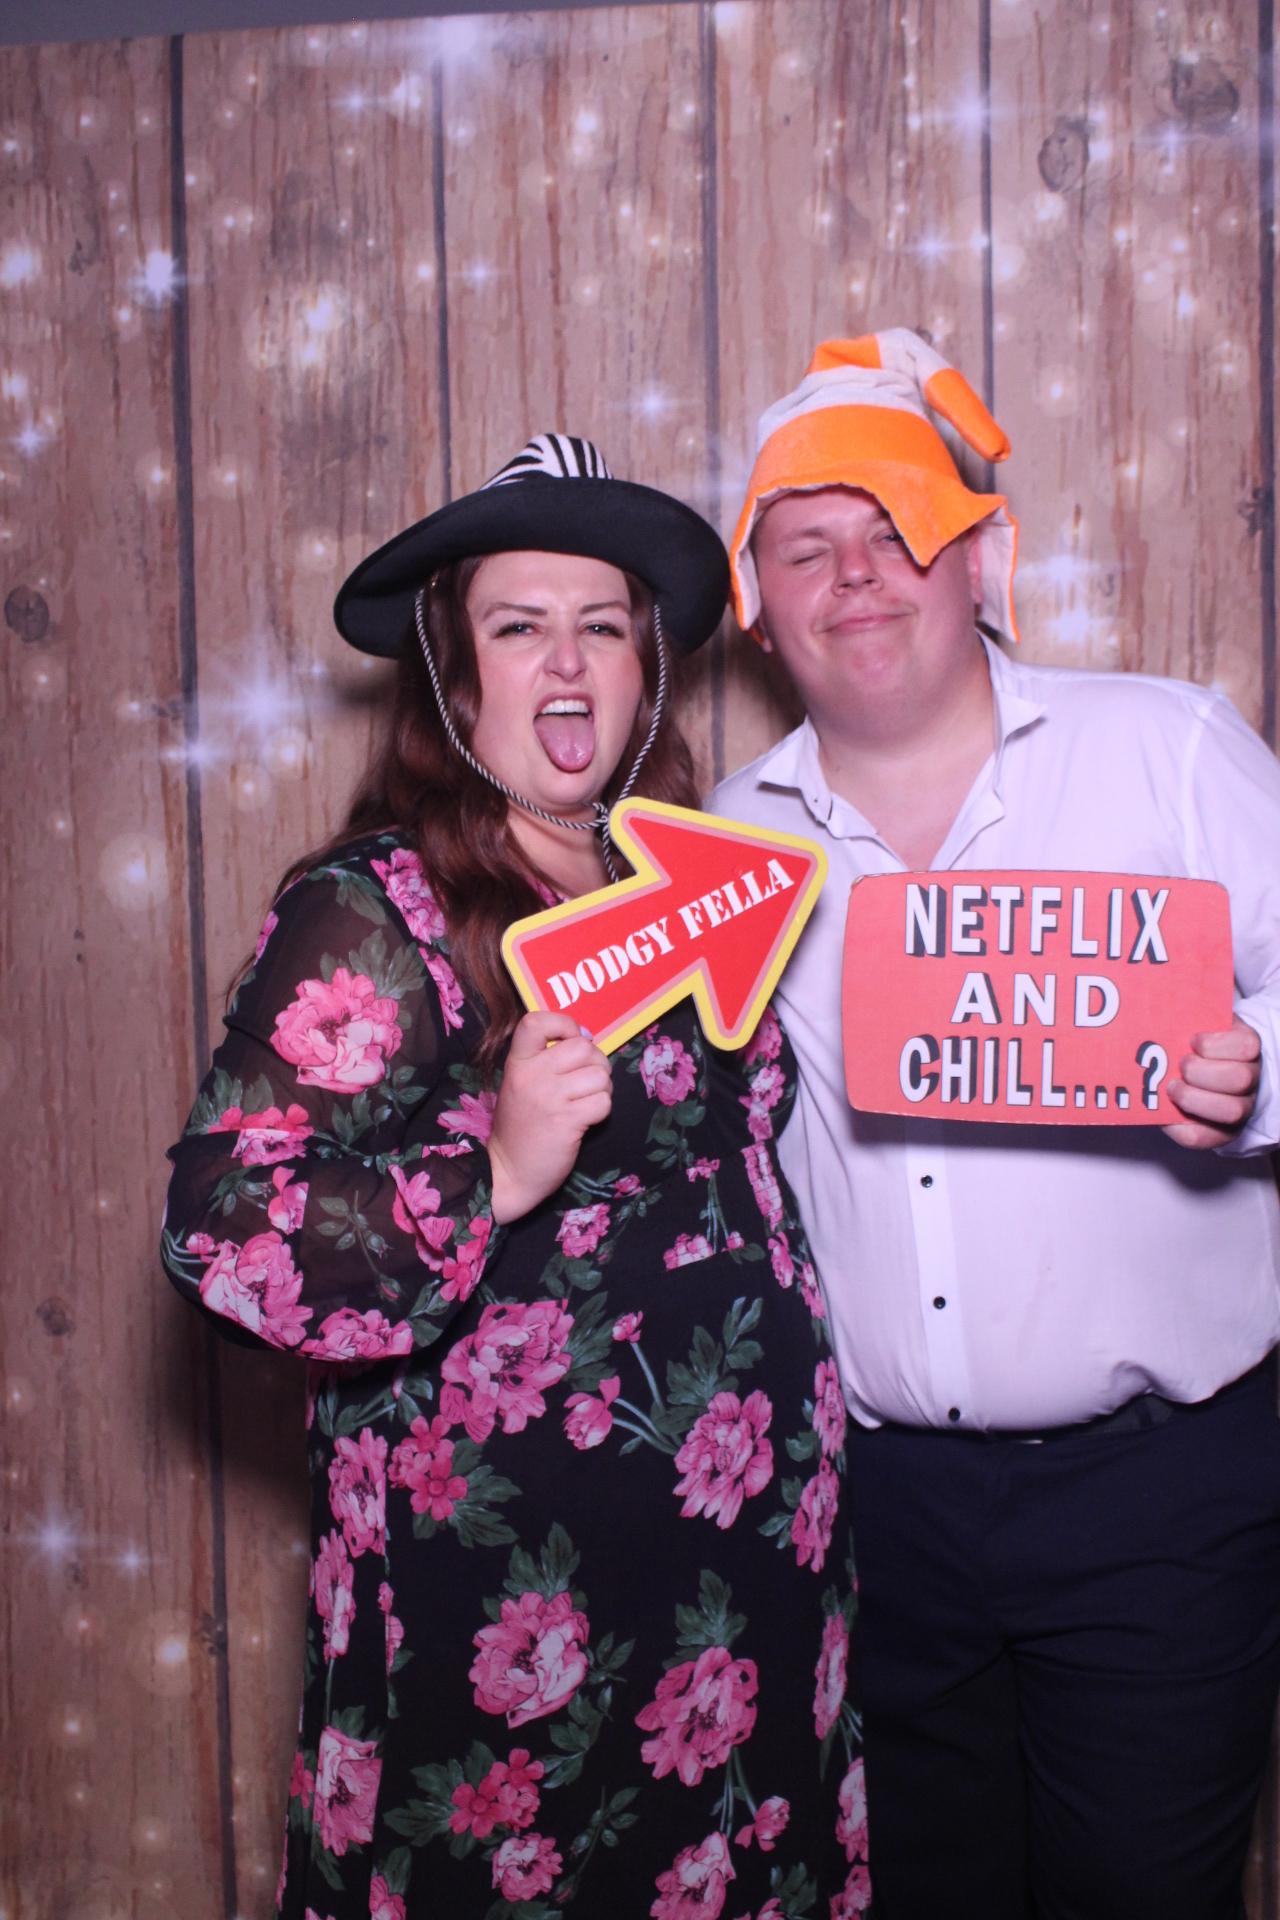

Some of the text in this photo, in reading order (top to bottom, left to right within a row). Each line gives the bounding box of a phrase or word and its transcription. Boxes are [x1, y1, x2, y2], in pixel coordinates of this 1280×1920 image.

[547, 859, 795, 1010] DODGY FELLA
[905, 883, 1170, 963] NETFLIX
[950, 972, 1121, 1028] AND
